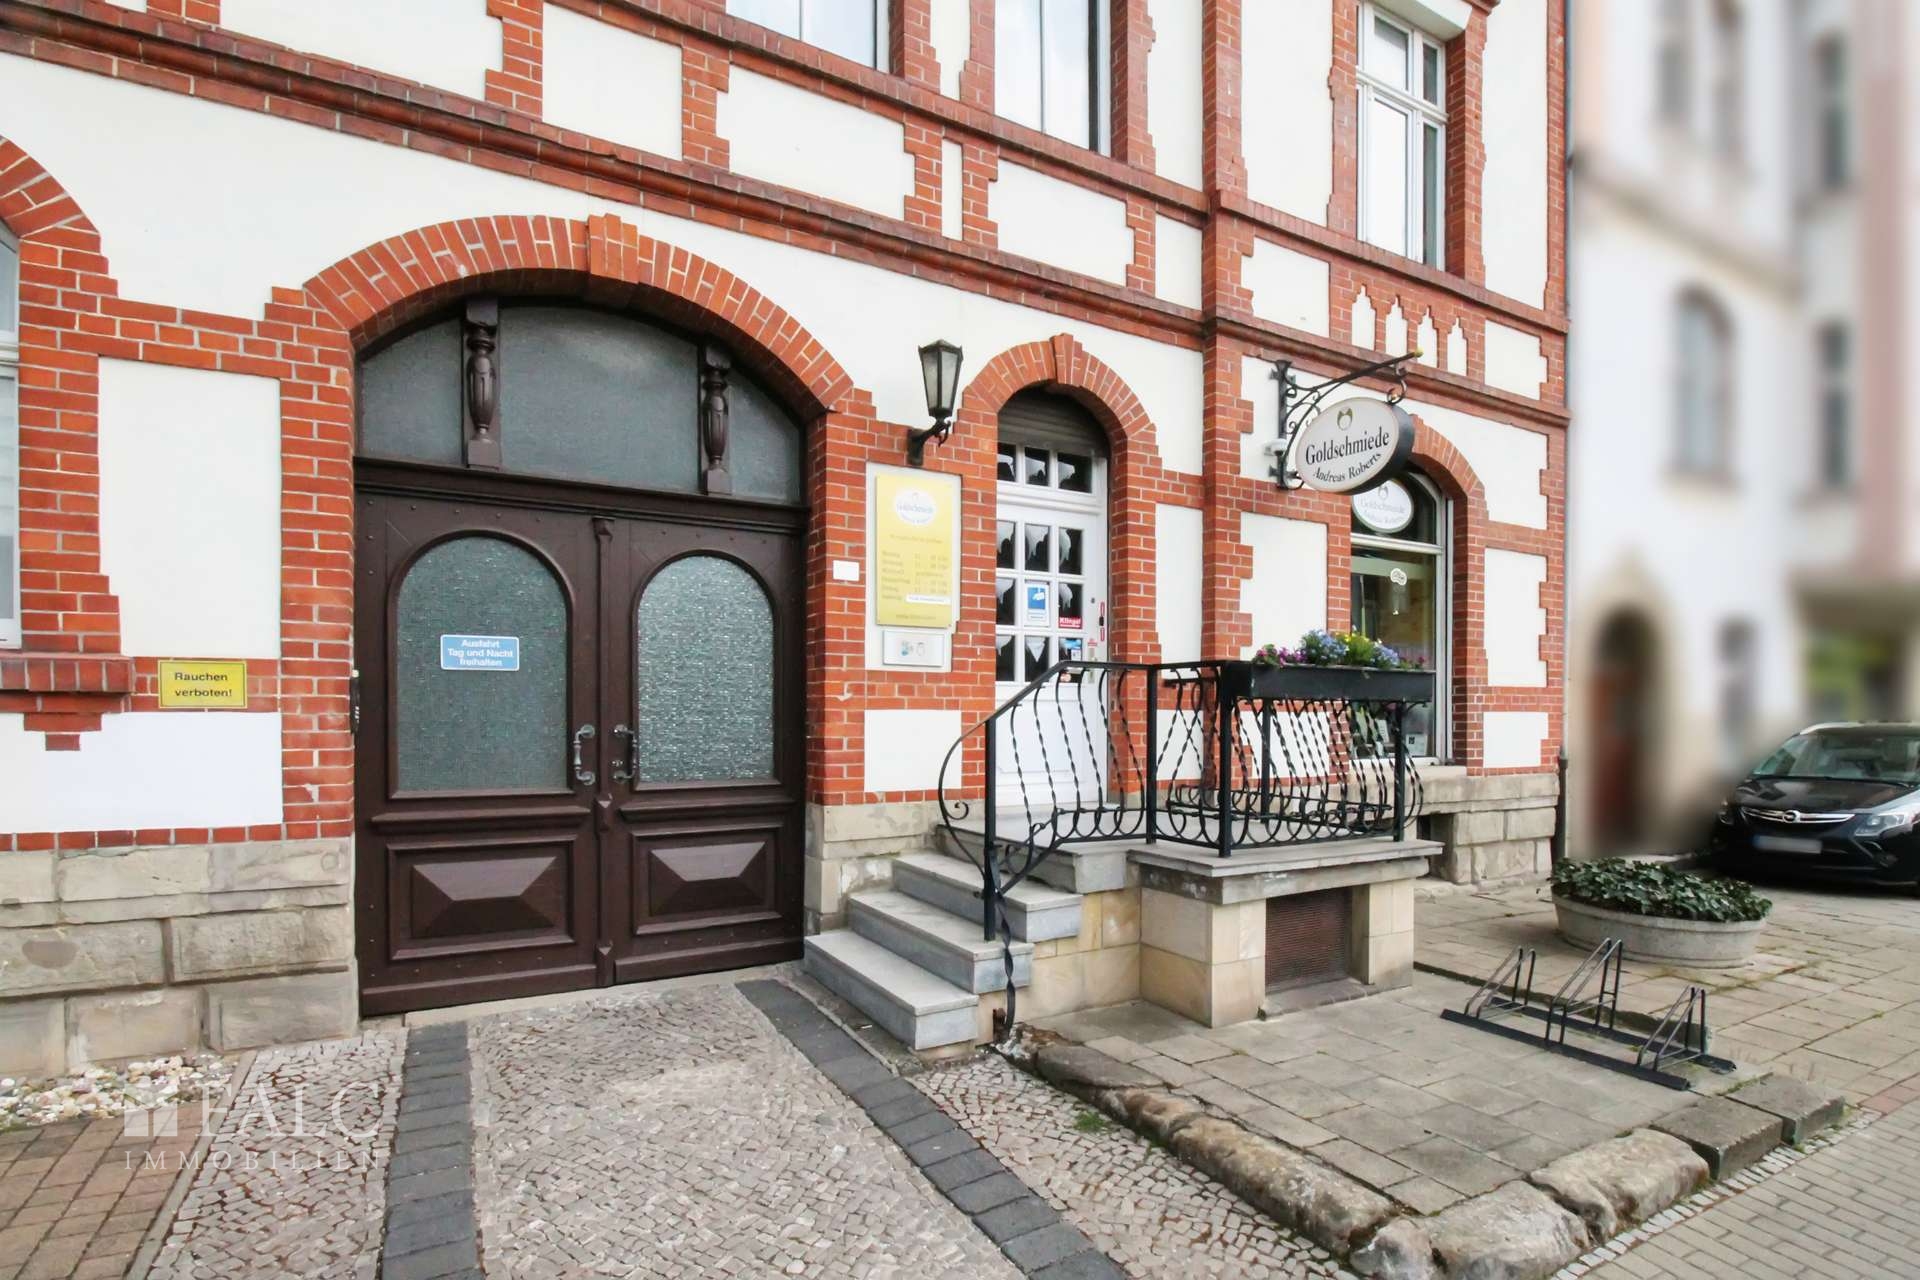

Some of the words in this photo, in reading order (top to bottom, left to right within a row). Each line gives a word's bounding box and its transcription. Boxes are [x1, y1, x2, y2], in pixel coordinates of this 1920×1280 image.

[1306, 426, 1389, 465] Goldschmiede
[1313, 467, 1346, 482] Andreas
[1348, 453, 1381, 479] Roberts
[462, 639, 500, 647] Ausfahrt
[447, 648, 464, 658] Tag
[487, 649, 513, 657] Nacht
[460, 658, 502, 666] freihalten
[174, 672, 228, 681] Rauchen
[174, 688, 232, 697] verboten!
